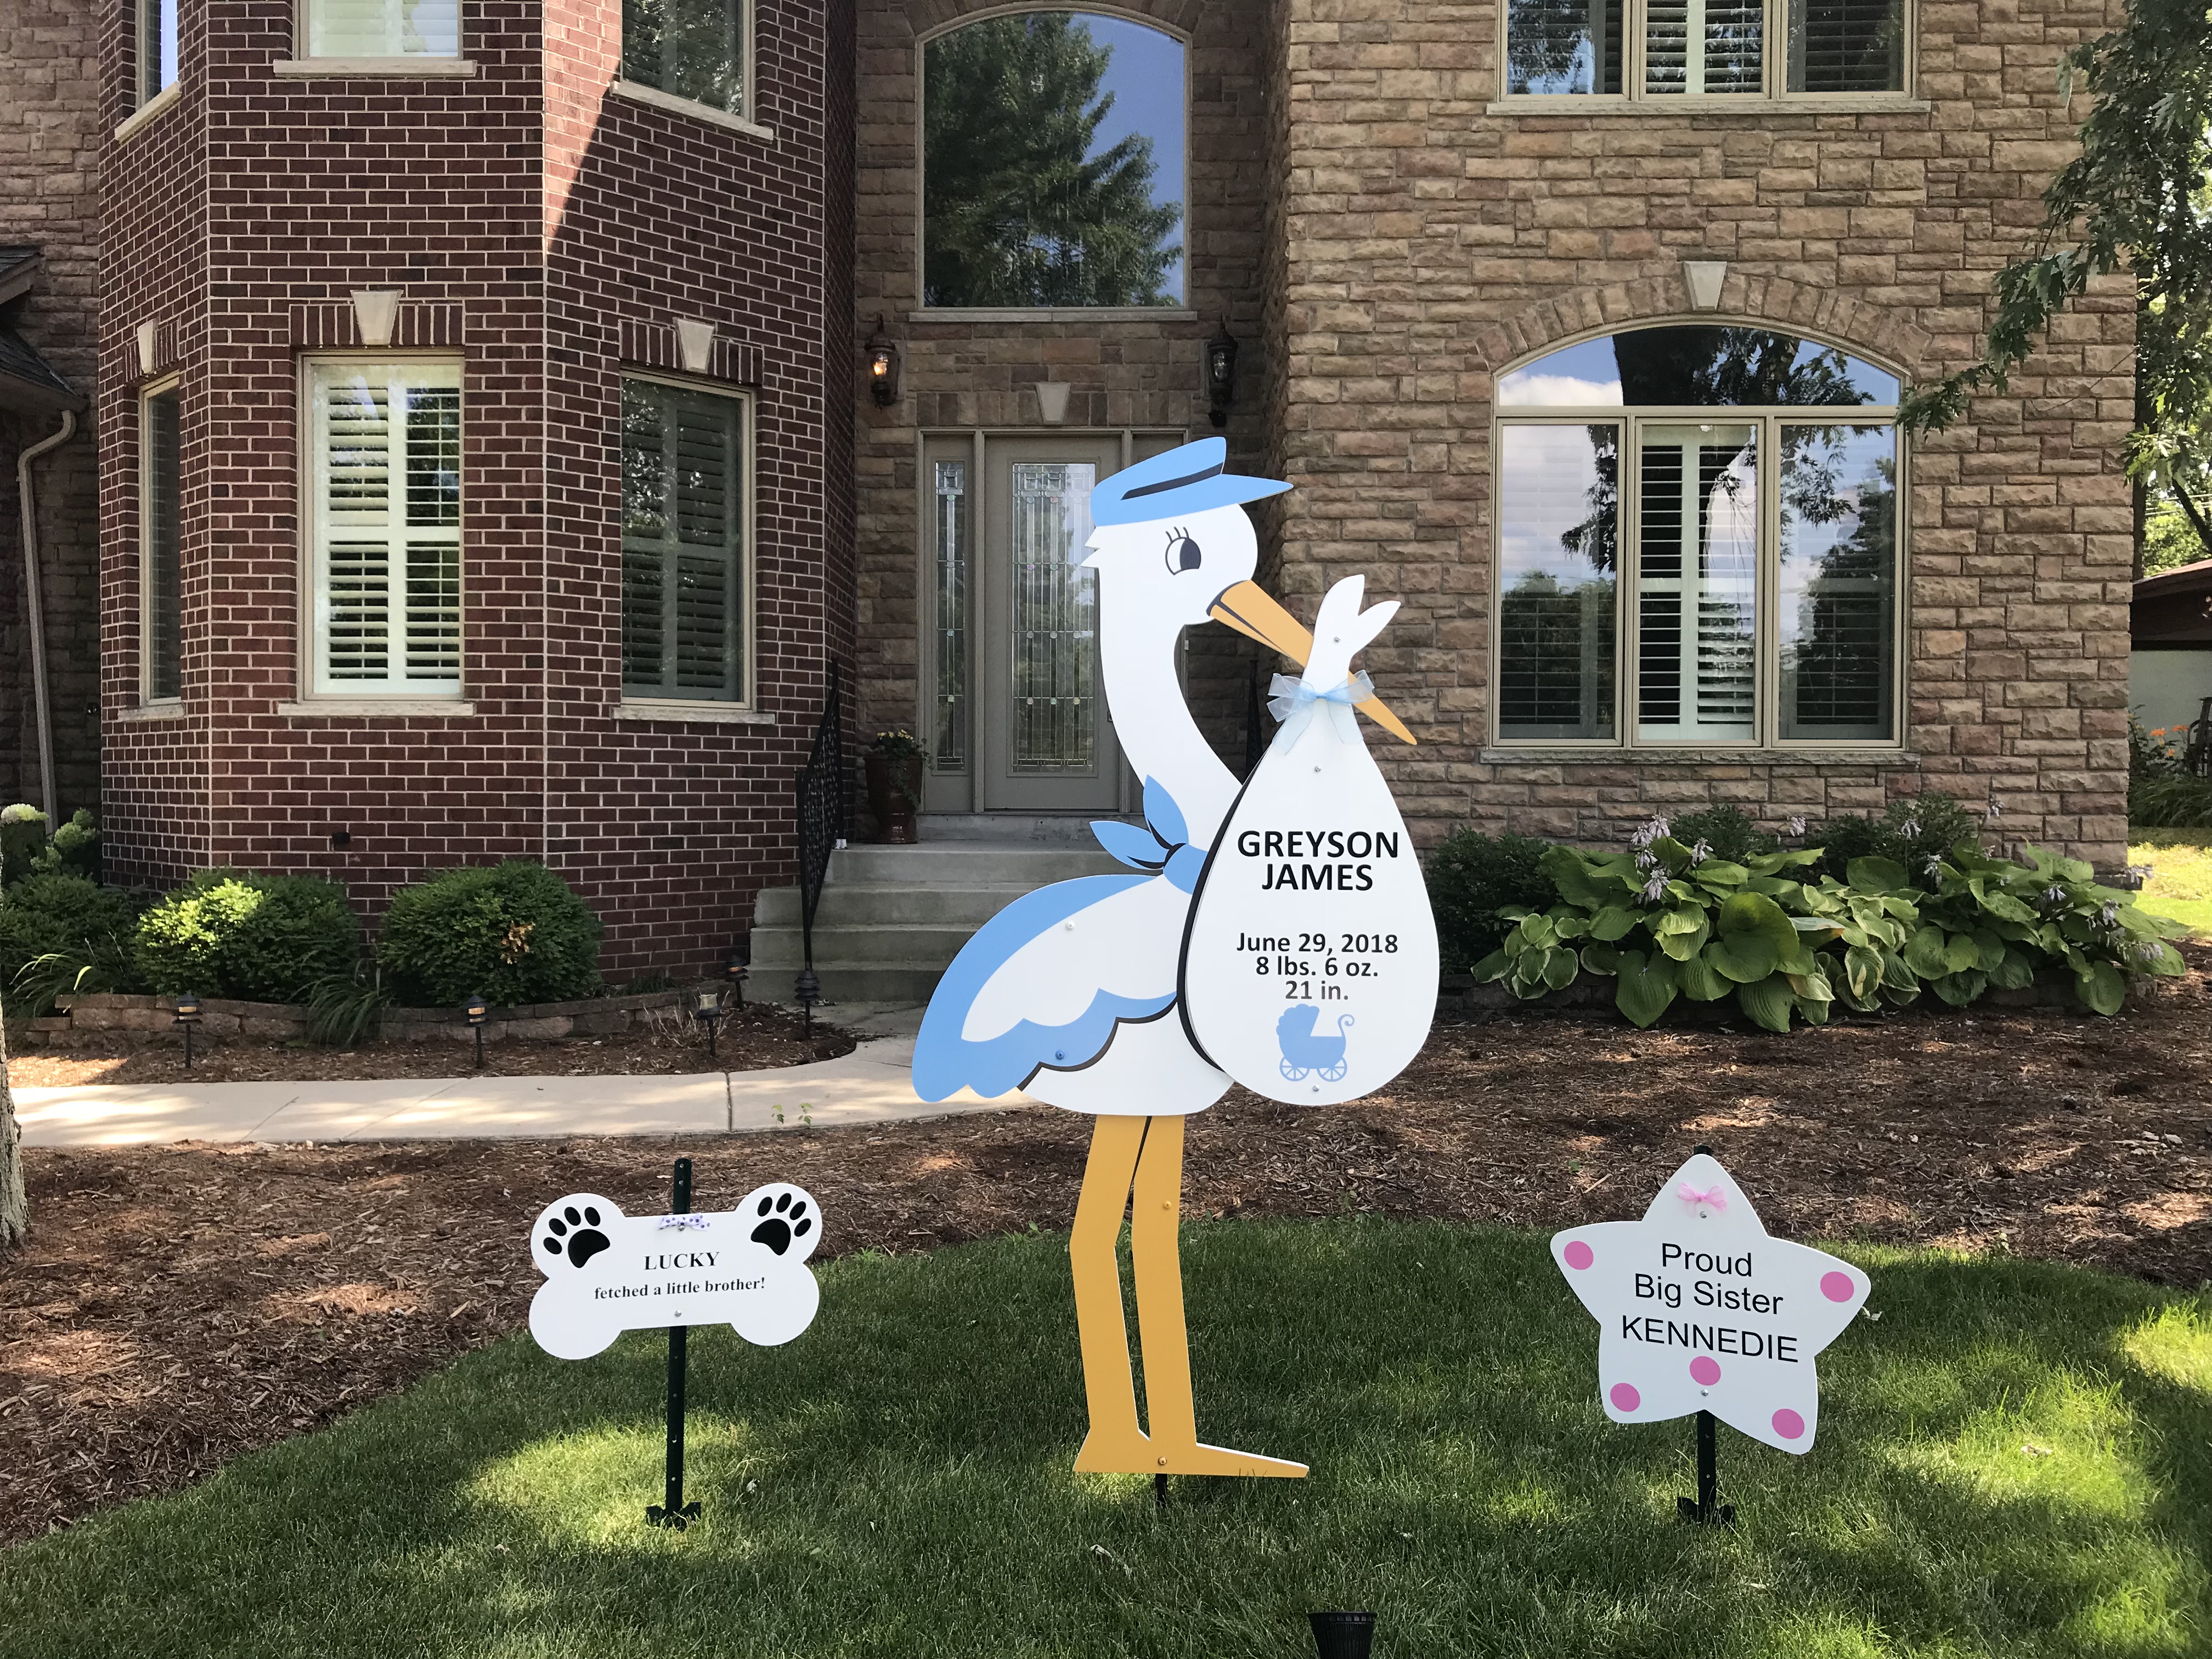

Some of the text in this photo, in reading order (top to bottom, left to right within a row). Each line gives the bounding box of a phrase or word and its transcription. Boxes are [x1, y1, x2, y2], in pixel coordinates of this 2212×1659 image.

[1238, 831, 1398, 858] GREYSON
[1262, 864, 1373, 891] JAMES
[1237, 933, 1398, 956] June 29, 2018
[1256, 956, 1378, 977] 8 lbs. 6 oz.
[1285, 980, 1348, 1000] 21 in.
[644, 1251, 720, 1271] LUCKY
[1662, 1243, 1752, 1277] Proud
[594, 1277, 765, 1299] fetched a little brother!
[1635, 1273, 1784, 1314] Big Sister
[1622, 1315, 1798, 1363] KENNEDIE
